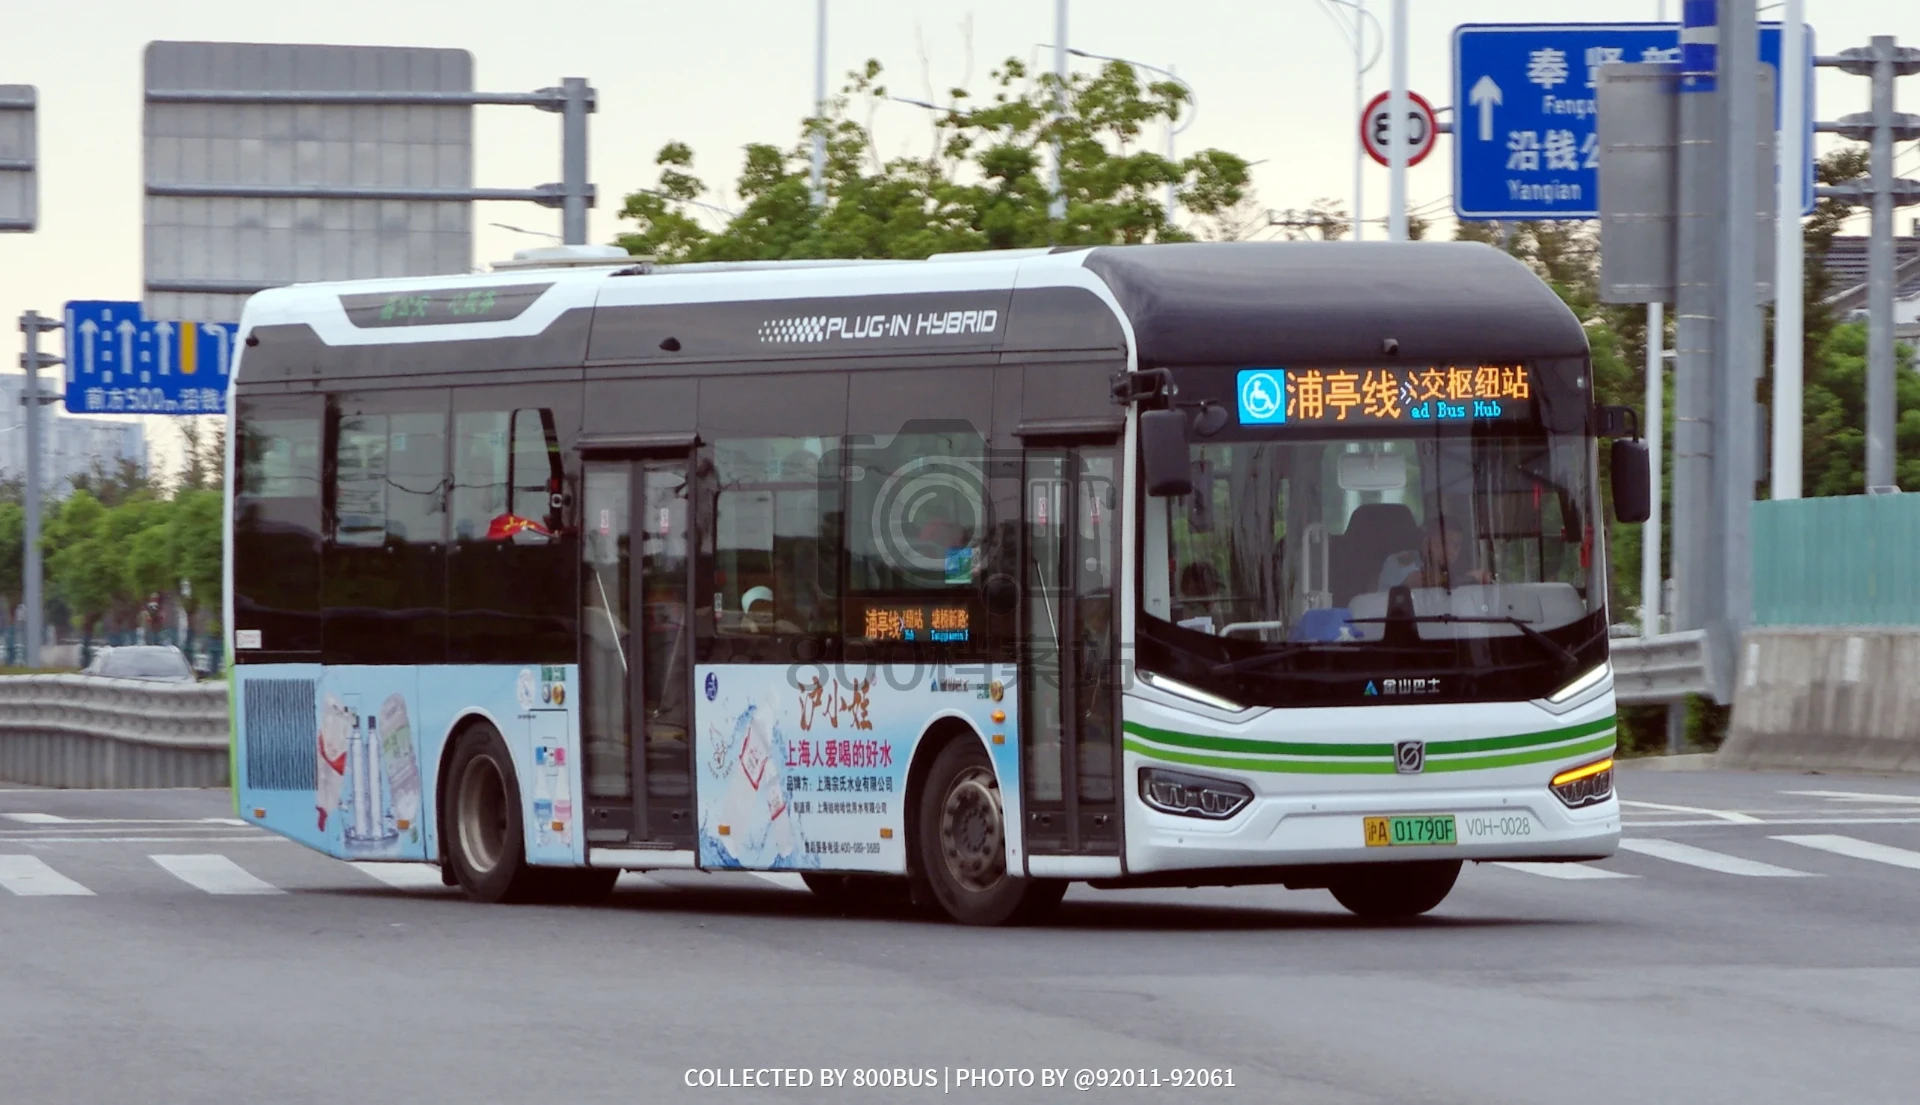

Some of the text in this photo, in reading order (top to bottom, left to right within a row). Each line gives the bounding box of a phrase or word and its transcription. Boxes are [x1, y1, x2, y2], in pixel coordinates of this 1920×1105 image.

[916, 310, 998, 336] HYBRID
[1287, 369, 1401, 420] 浦亭线
[1437, 402, 1465, 418] Bus
[1474, 401, 1502, 417] Hub
[1383, 678, 1440, 694] 金山巴士
[785, 738, 893, 769] 上海人爱喝的好水
